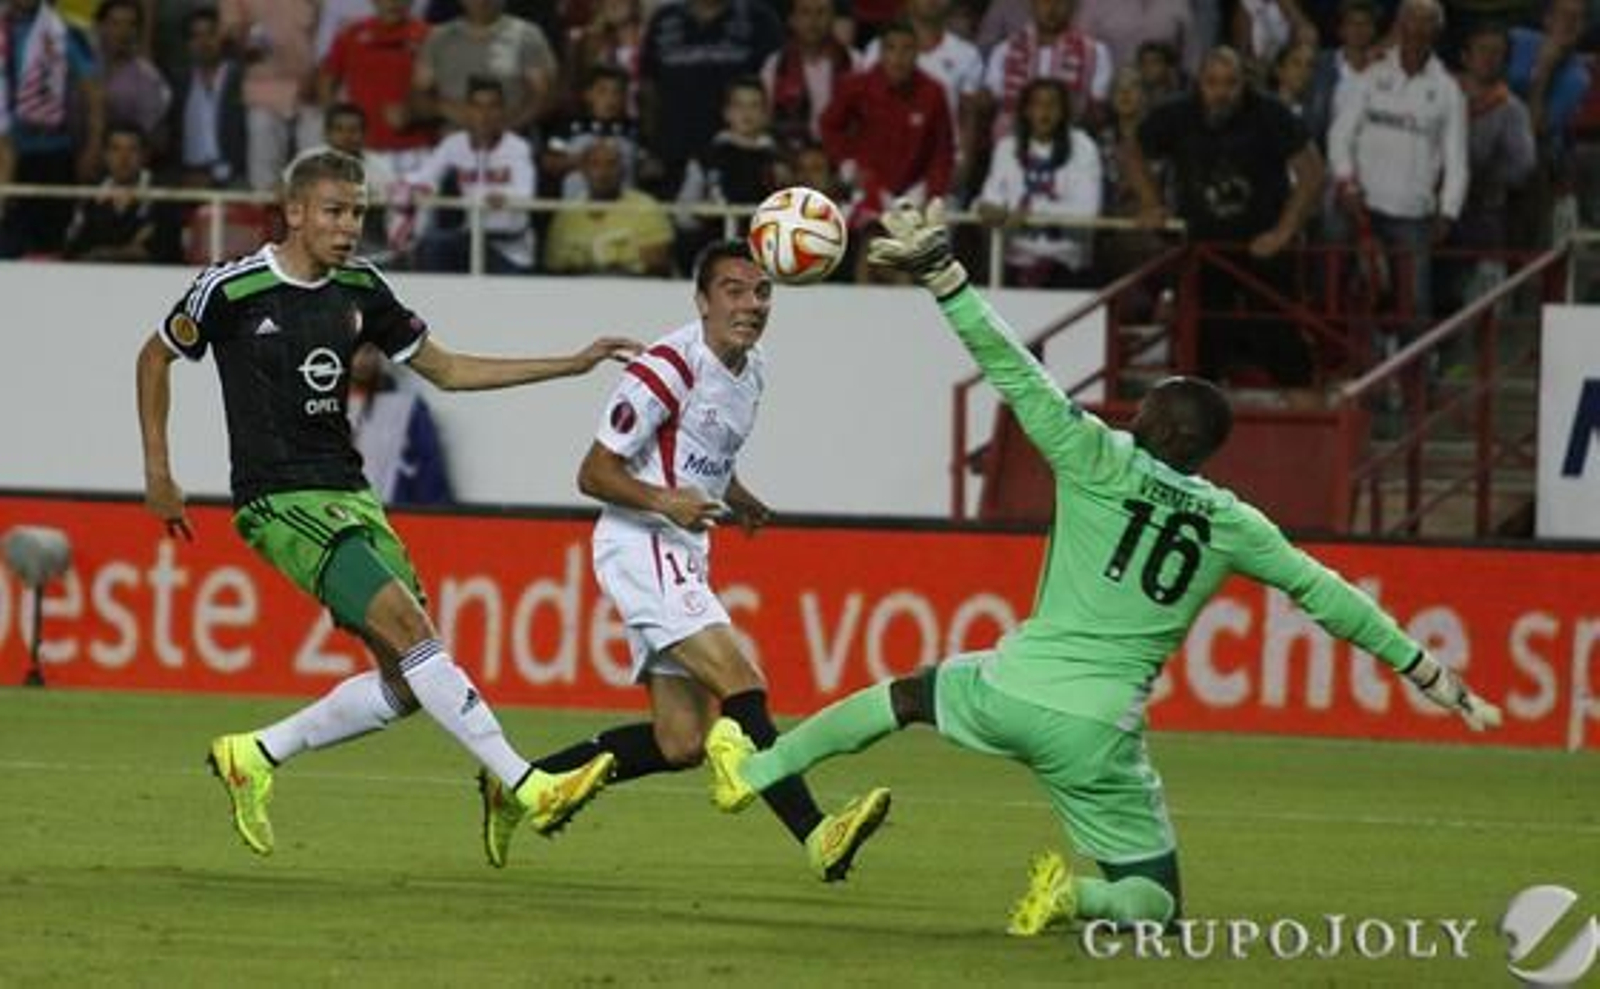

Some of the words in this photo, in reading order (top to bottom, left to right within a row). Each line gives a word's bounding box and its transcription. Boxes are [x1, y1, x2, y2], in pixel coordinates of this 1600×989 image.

[665, 551, 704, 585] 14
[1103, 498, 1211, 605] 16
[0, 537, 258, 674] este
[1152, 577, 1470, 717] chte
